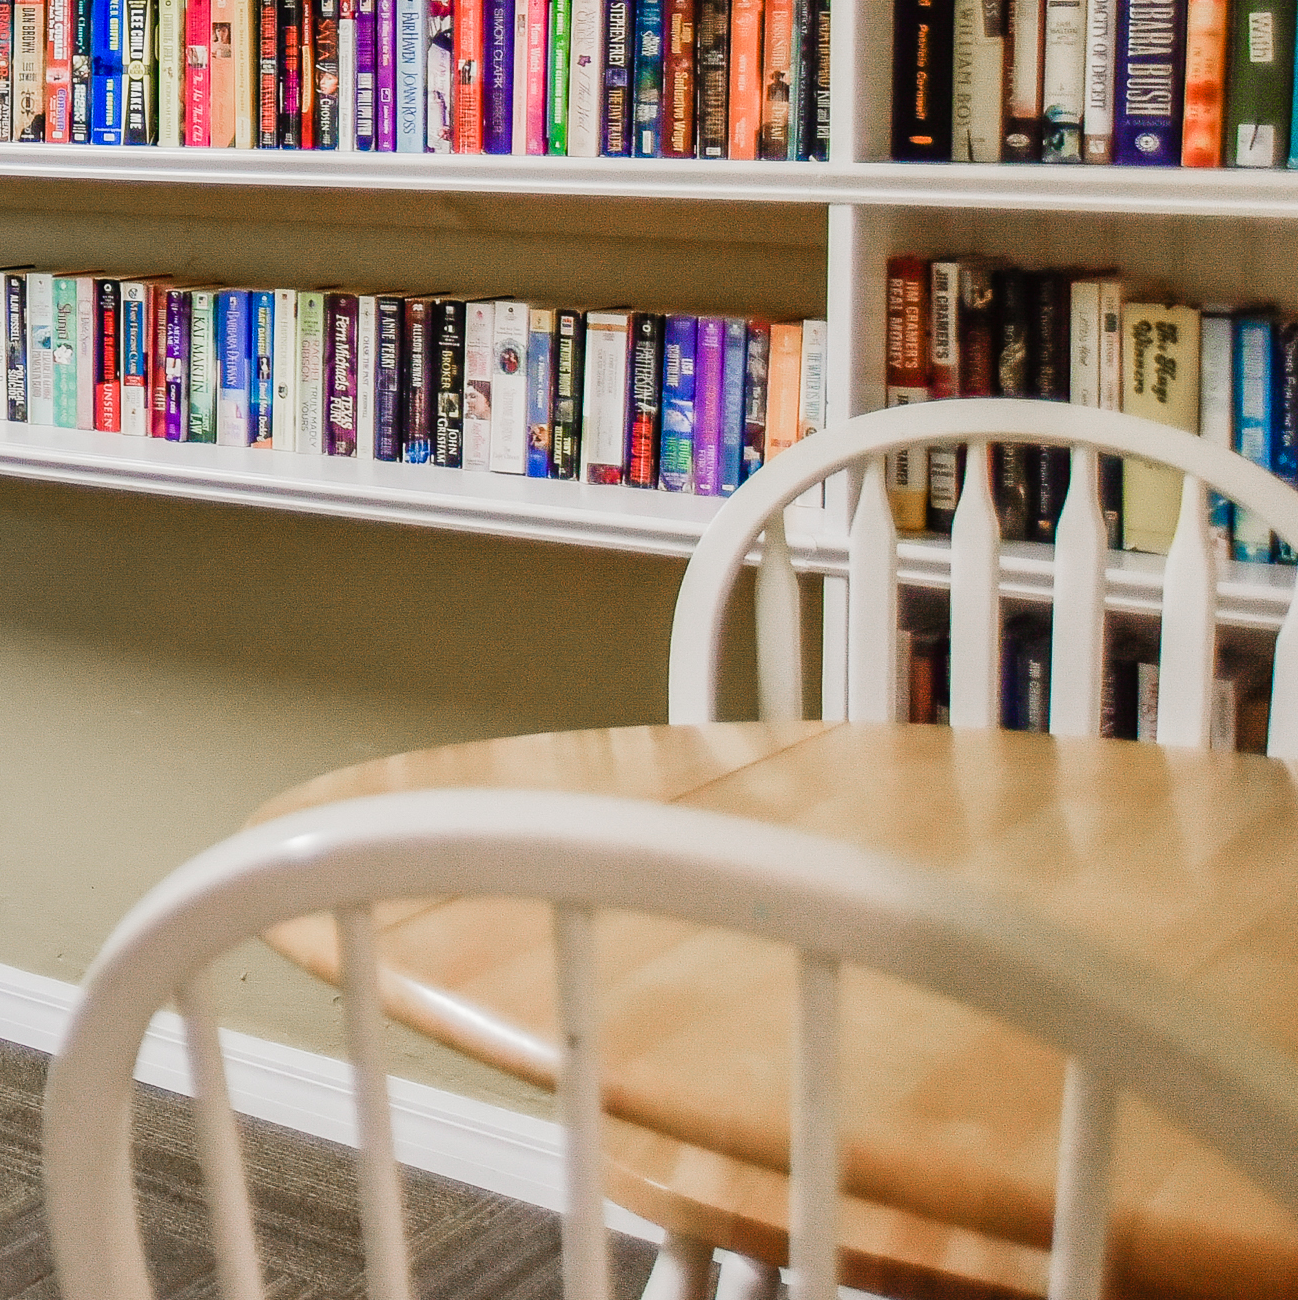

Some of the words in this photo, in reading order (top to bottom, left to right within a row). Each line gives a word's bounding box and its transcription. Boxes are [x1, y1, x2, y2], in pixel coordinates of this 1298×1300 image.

[22, 7, 36, 22] DAN
[131, 9, 144, 28] LEE
[493, 8, 503, 46] SIMON
[609, 2, 625, 42] STEPHEN
[22, 25, 35, 54] BROWN
[130, 29, 144, 59] CHILD
[609, 44, 625, 67] FREY
[917, 24, 929, 68] Patricia
[960, 6, 974, 87] WILLIAM
[1092, 43, 1109, 60] OF
[493, 49, 503, 89] CLARK
[130, 81, 143, 110] MAKE
[610, 89, 622, 104] THE
[914, 71, 928, 121] Cornwell
[1090, 64, 1108, 111] DECEIT
[1125, 63, 1173, 116] BUSH
[130, 113, 142, 130] ME
[402, 106, 417, 135] ROSS
[608, 105, 621, 120] DAY
[607, 122, 622, 152] TRADER
[888, 278, 903, 312] REAL
[904, 280, 920, 301] JIM
[935, 270, 950, 294] JIM
[335, 314, 349, 341] Fern
[887, 317, 904, 369] MONEY
[905, 305, 920, 369] CRAMER'S
[935, 296, 950, 360] CRAMER'S
[301, 339, 310, 383] GIBSON
[311, 339, 320, 382] RACHEL
[334, 344, 350, 391] Michaels
[103, 383, 114, 428] UNSEEN
[330, 397, 343, 426] FURY
[342, 395, 353, 430] TEXAS
[436, 418, 449, 463] GRISHAM
[448, 427, 459, 455] JOHN
